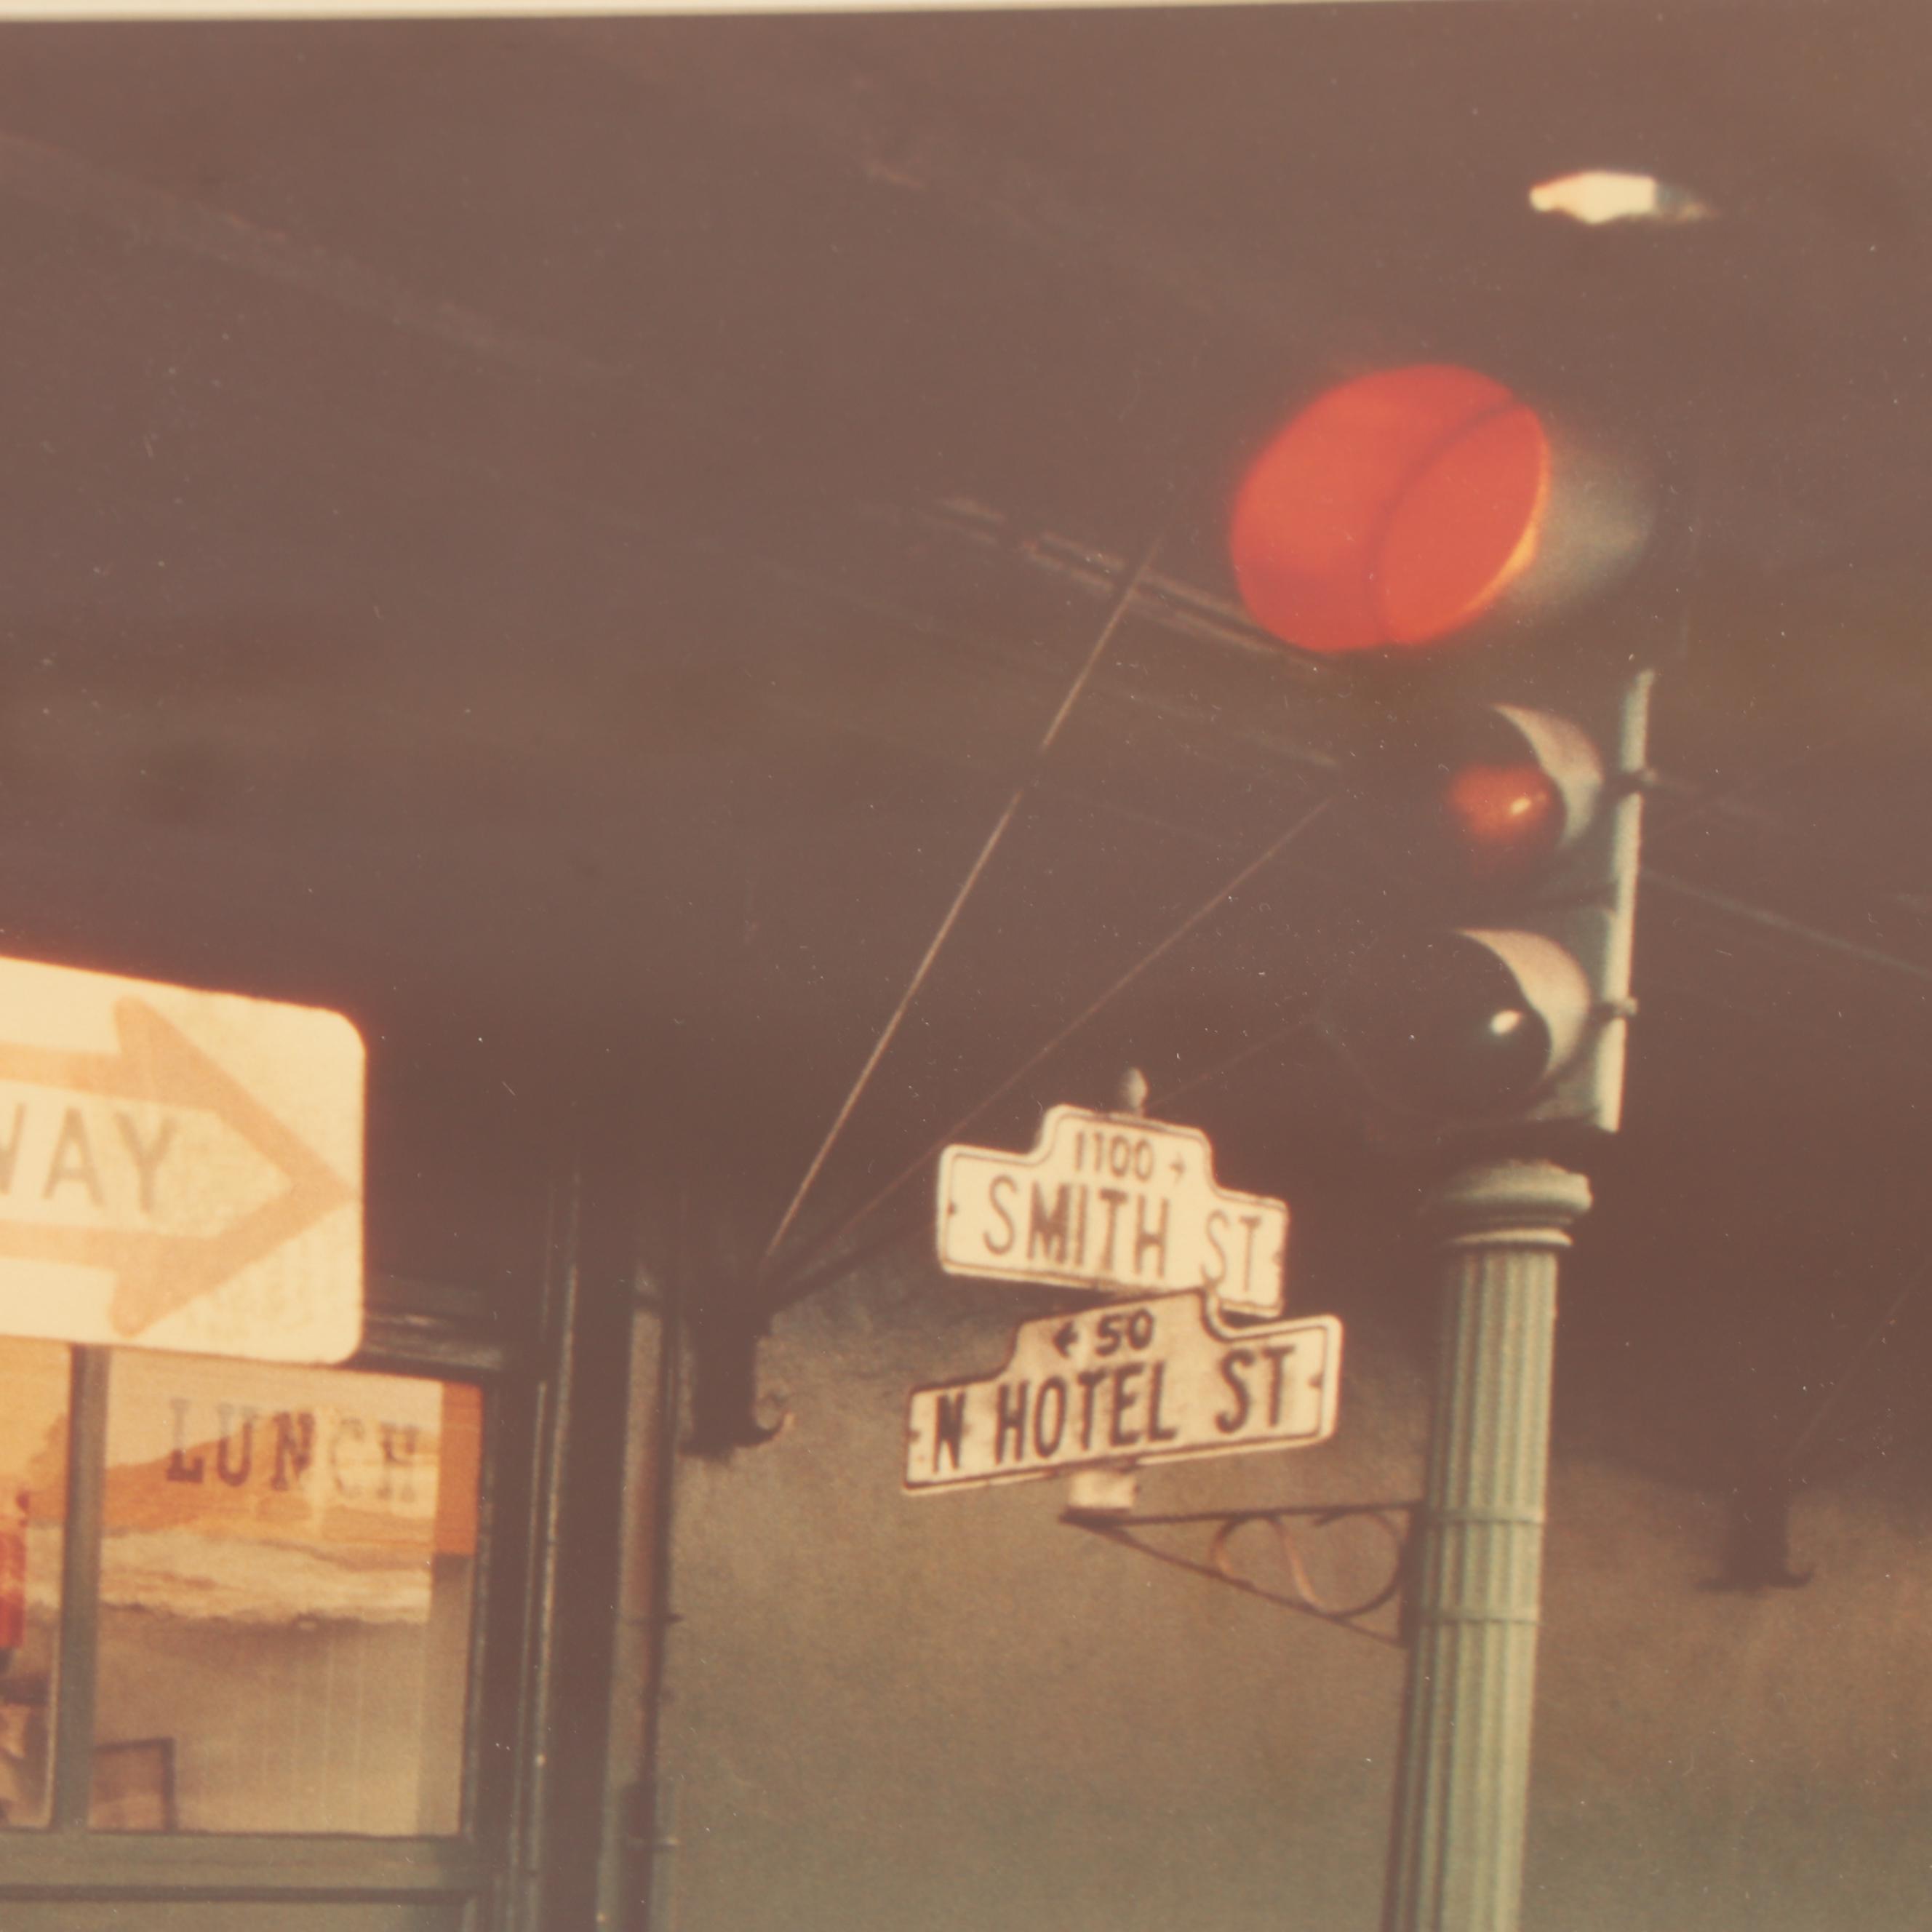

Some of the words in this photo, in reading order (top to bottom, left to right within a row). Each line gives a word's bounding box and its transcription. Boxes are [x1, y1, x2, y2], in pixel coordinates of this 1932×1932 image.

[1074, 1131, 1156, 1182] 1100
[982, 1173, 1170, 1279] SMITH
[1200, 1209, 1262, 1293] ST
[1093, 1309, 1155, 1357] 50
[166, 1397, 420, 1503] LUNCH
[931, 1392, 967, 1474] N
[993, 1360, 1178, 1466] HOTEL
[1215, 1345, 1296, 1434] ST
